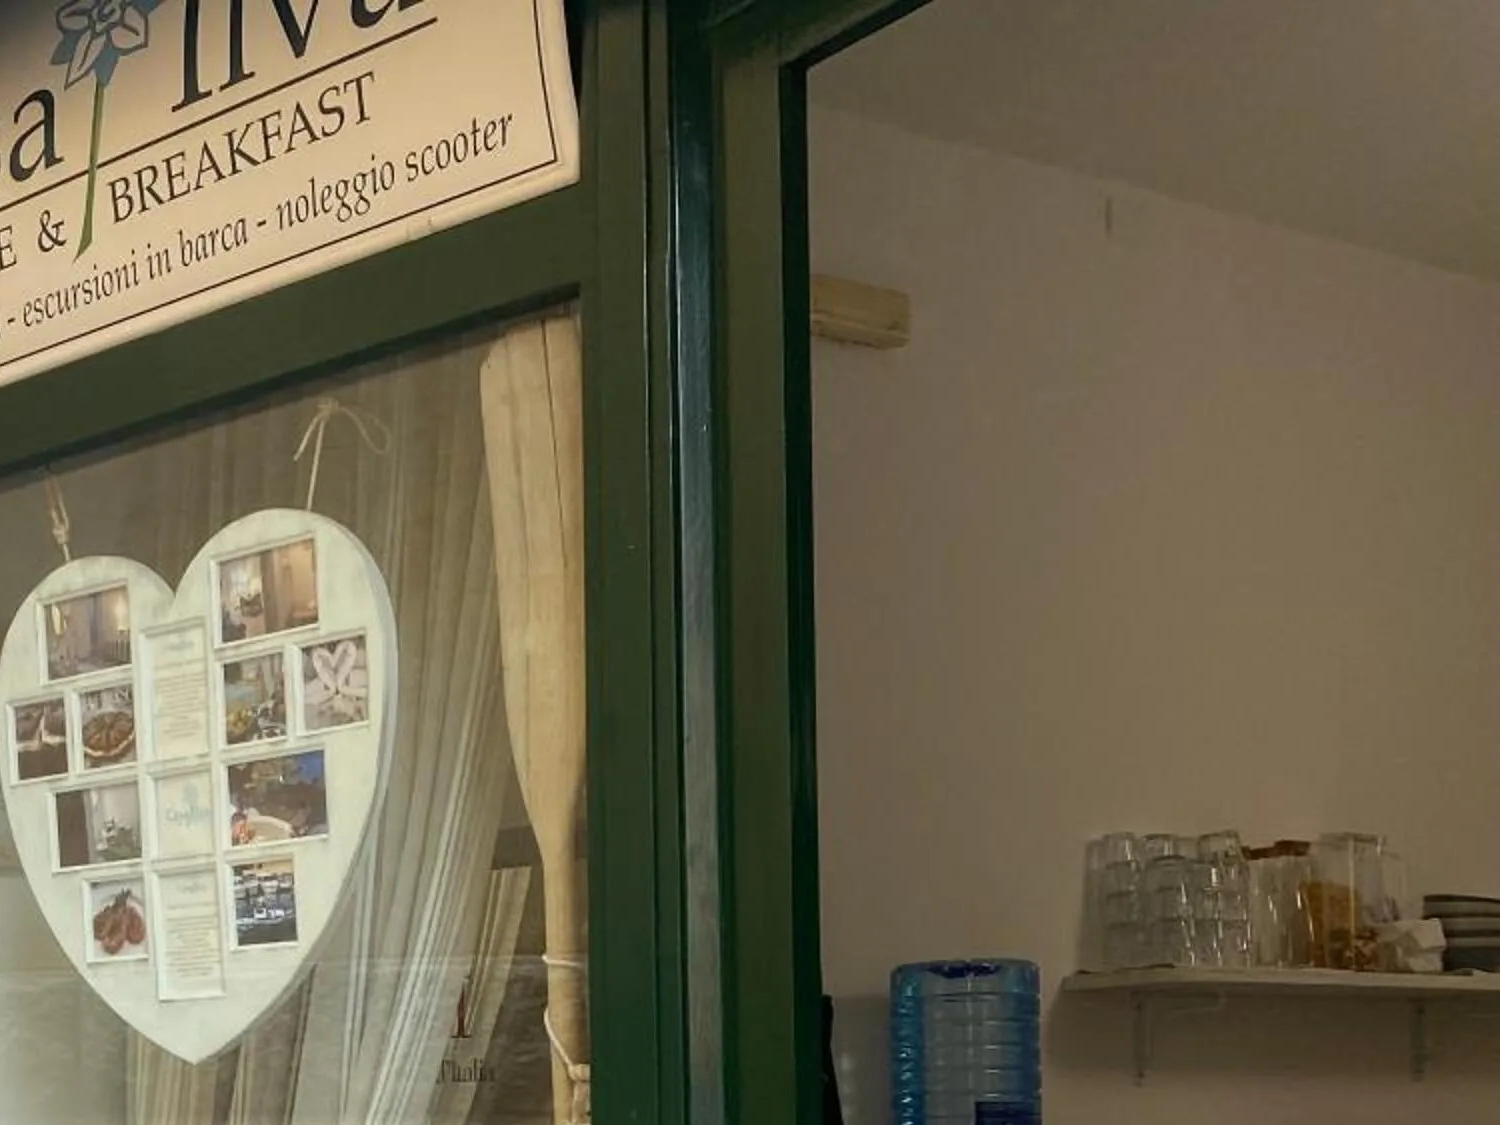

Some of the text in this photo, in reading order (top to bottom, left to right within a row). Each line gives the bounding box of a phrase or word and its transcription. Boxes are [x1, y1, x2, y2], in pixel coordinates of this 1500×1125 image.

[23, 249, 141, 327] escursioni
[147, 242, 172, 281] in
[179, 229, 248, 268] barca
[276, 154, 396, 232] noleggio
[405, 112, 514, 183] scooter
[37, 209, 68, 253] &
[107, 71, 376, 225] BREAKFAST
